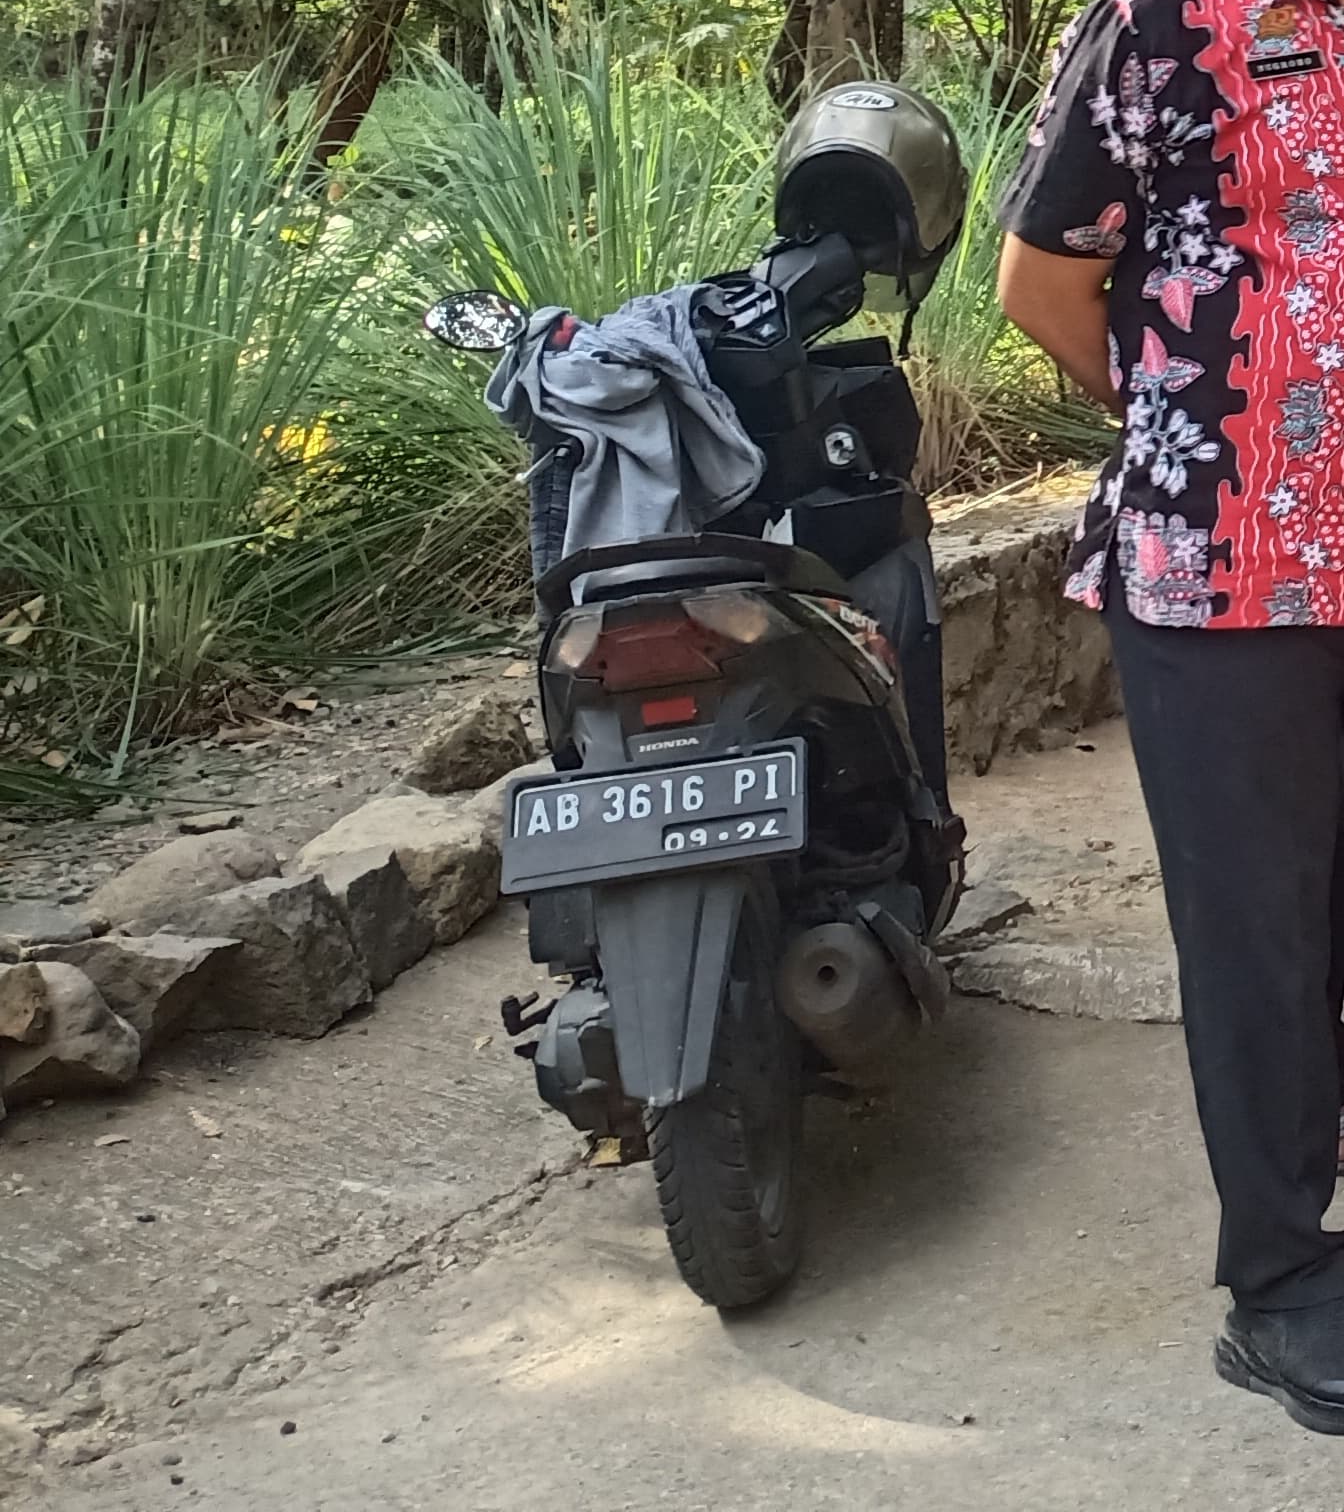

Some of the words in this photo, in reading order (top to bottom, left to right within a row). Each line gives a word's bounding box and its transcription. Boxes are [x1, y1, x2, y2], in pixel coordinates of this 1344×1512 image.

[638, 737, 700, 753] HONDA
[526, 793, 580, 836] AB
[602, 775, 704, 823] 3616
[733, 764, 778, 805] PI
